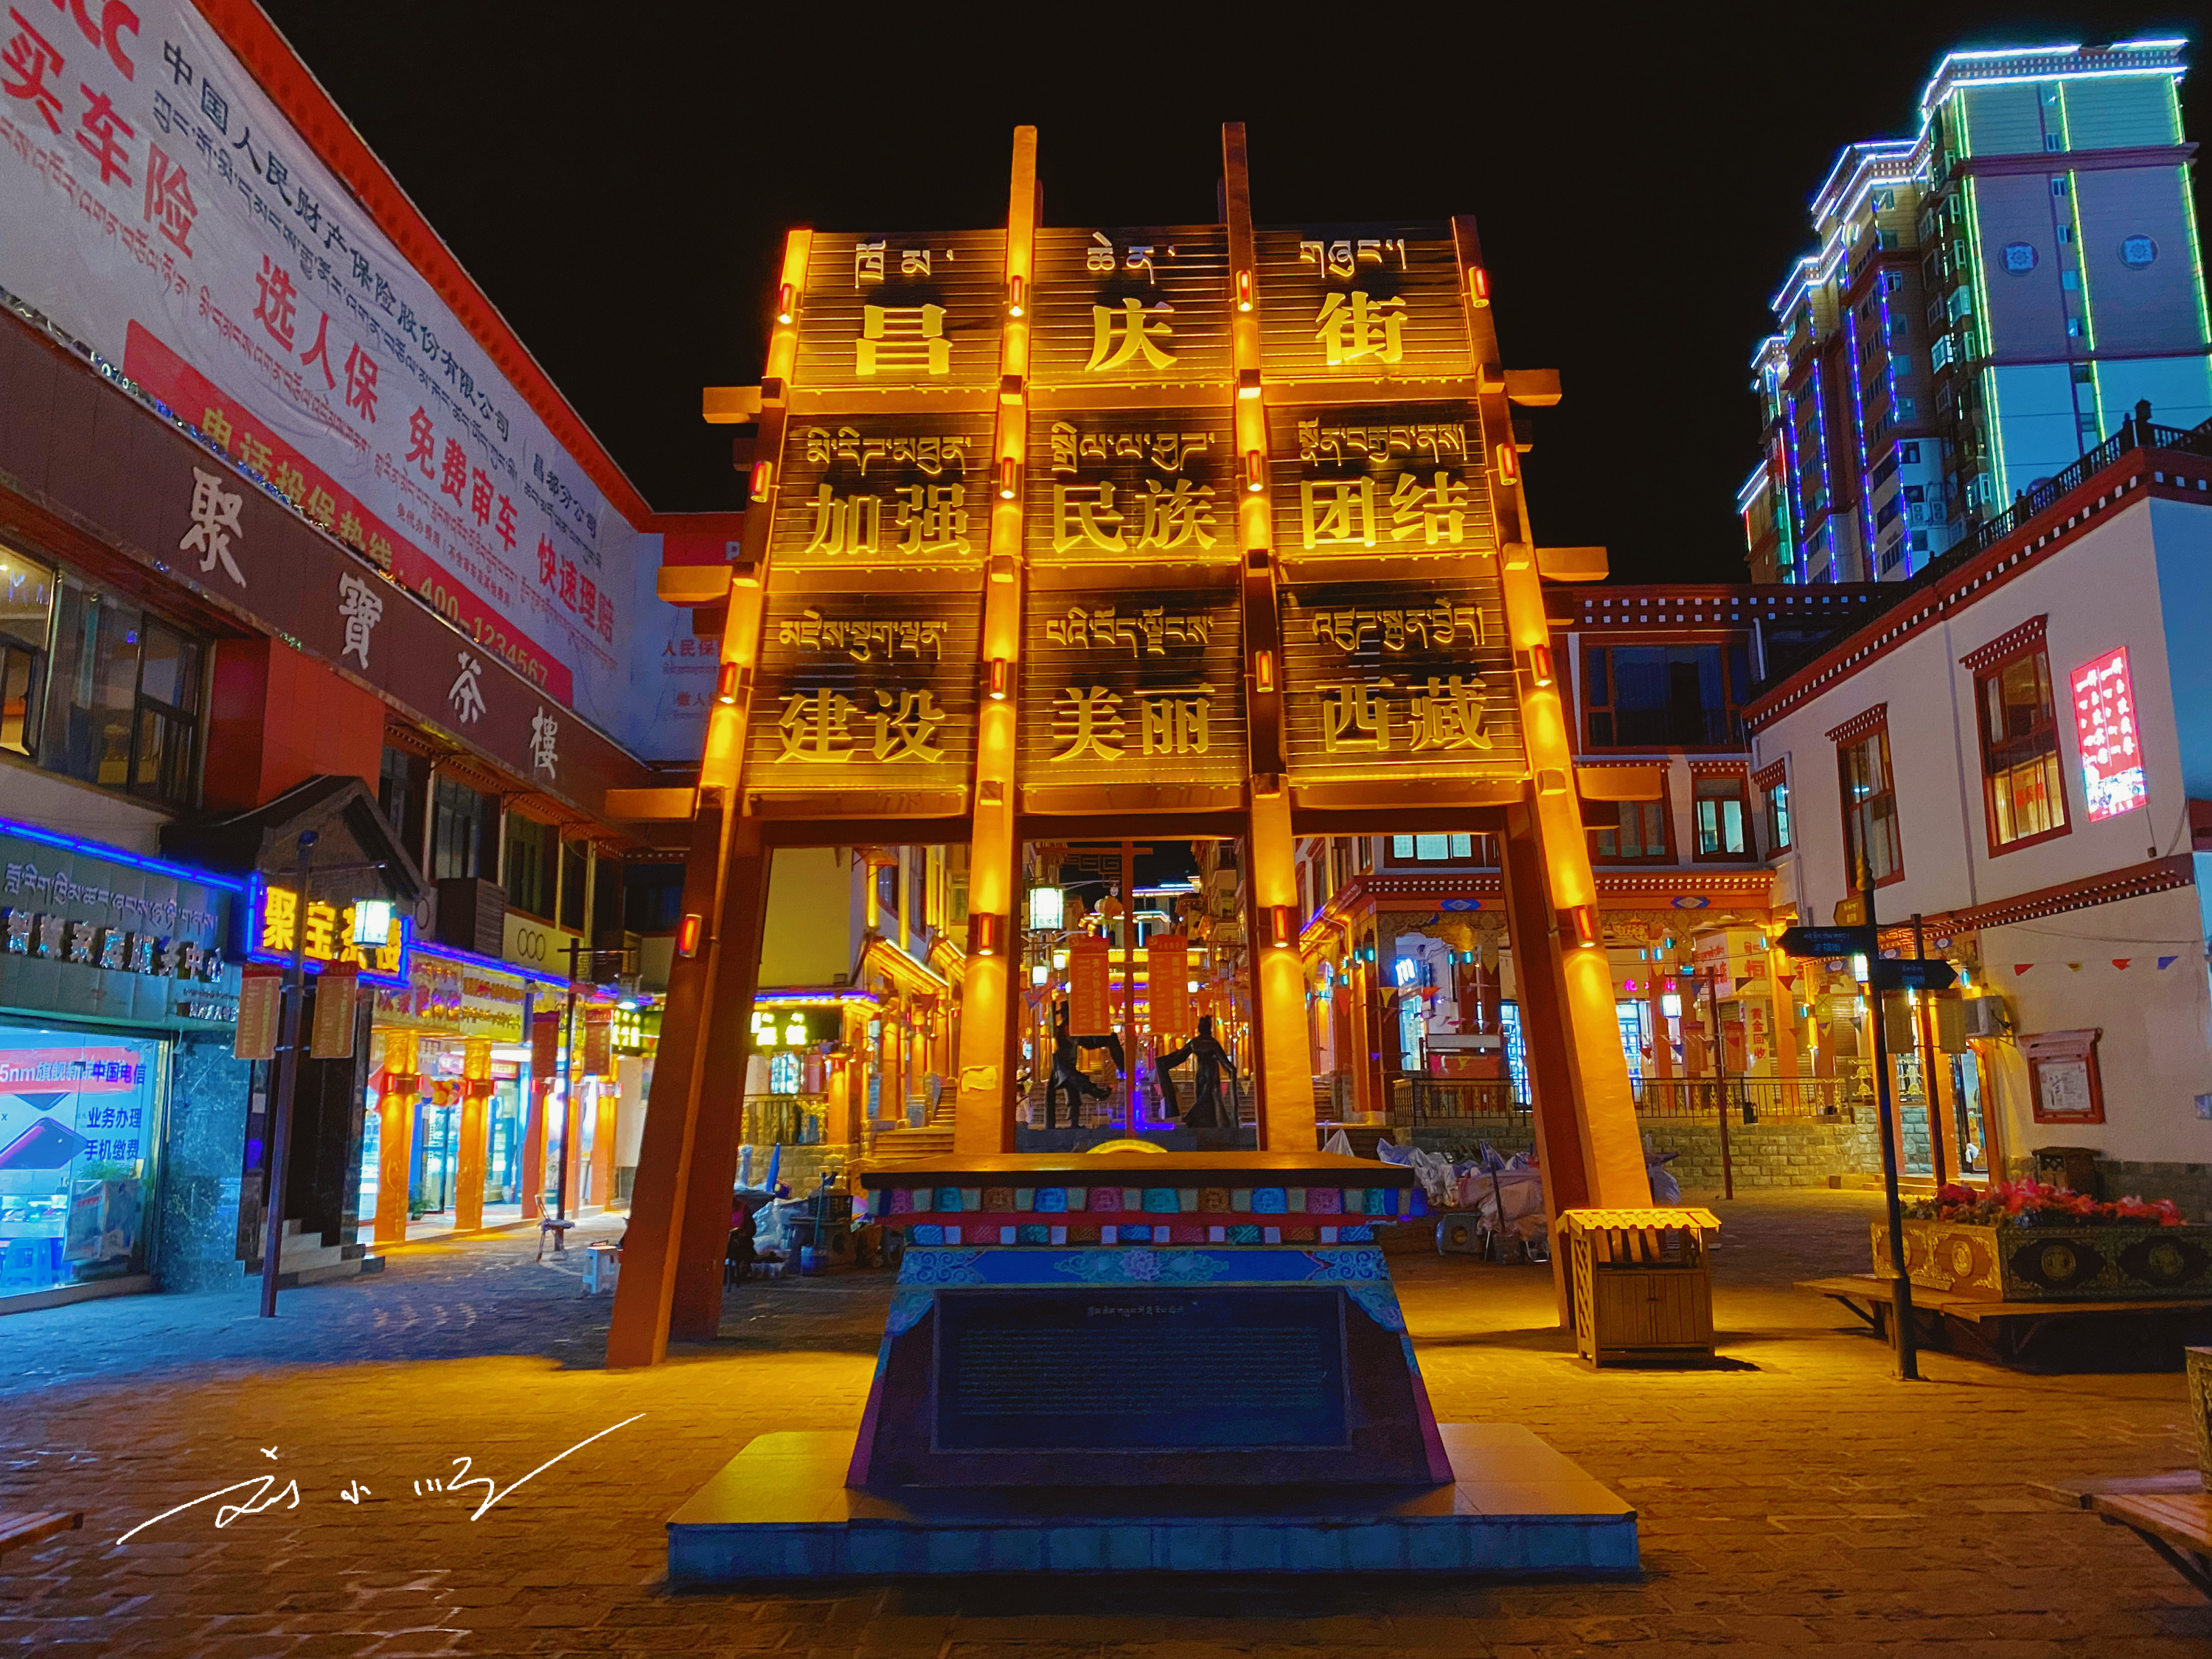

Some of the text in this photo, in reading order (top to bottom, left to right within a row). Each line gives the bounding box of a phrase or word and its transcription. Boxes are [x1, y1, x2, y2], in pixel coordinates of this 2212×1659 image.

[0, 6, 198, 260] 买车险
[253, 254, 378, 425] 选人保
[406, 406, 517, 552] 免费审车
[1750, 1007, 1767, 1060] 黄金回收
[86, 1107, 142, 1129] 业务办理
[84, 1139, 139, 1161] 手机缴费
